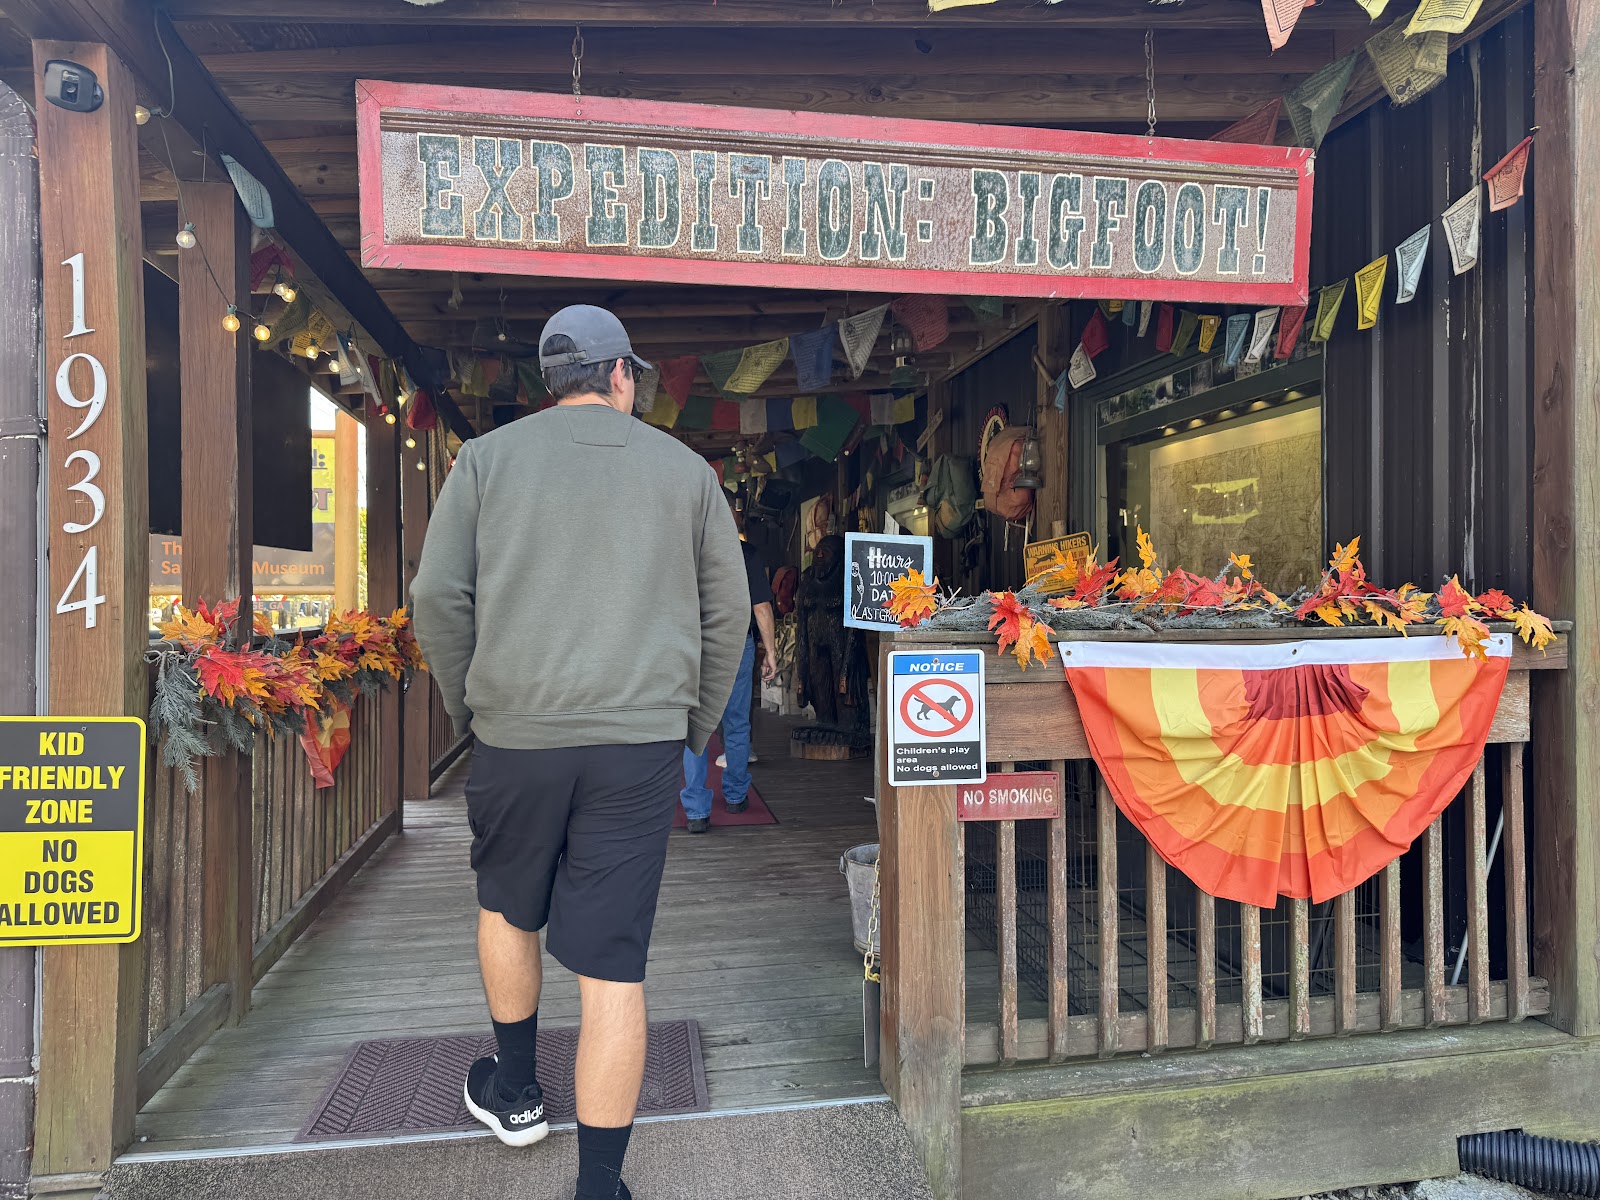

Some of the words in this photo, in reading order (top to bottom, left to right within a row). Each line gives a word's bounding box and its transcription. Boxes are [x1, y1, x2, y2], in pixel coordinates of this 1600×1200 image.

[417, 132, 936, 261] EXPEDITION:
[969, 168, 1272, 275] BIGFOOT!
[55, 252, 108, 630] 1934
[161, 541, 182, 556] Th
[1060, 536, 1087, 551] HIKERS
[253, 561, 325, 575] Museum
[867, 546, 914, 569] Hours
[909, 662, 965, 673] NOTICE
[39, 732, 85, 756] KID
[896, 746, 947, 755] Children's
[949, 745, 970, 755] play
[0, 765, 126, 790] FRIENDLY
[913, 764, 938, 774] dogs
[940, 762, 978, 771] allowed
[963, 789, 985, 806] NO
[988, 788, 1054, 805] SMOKING
[25, 799, 93, 824] ZONE
[42, 839, 78, 863] NO
[24, 869, 94, 894] DOGS
[0, 901, 120, 926] ALLOWED
